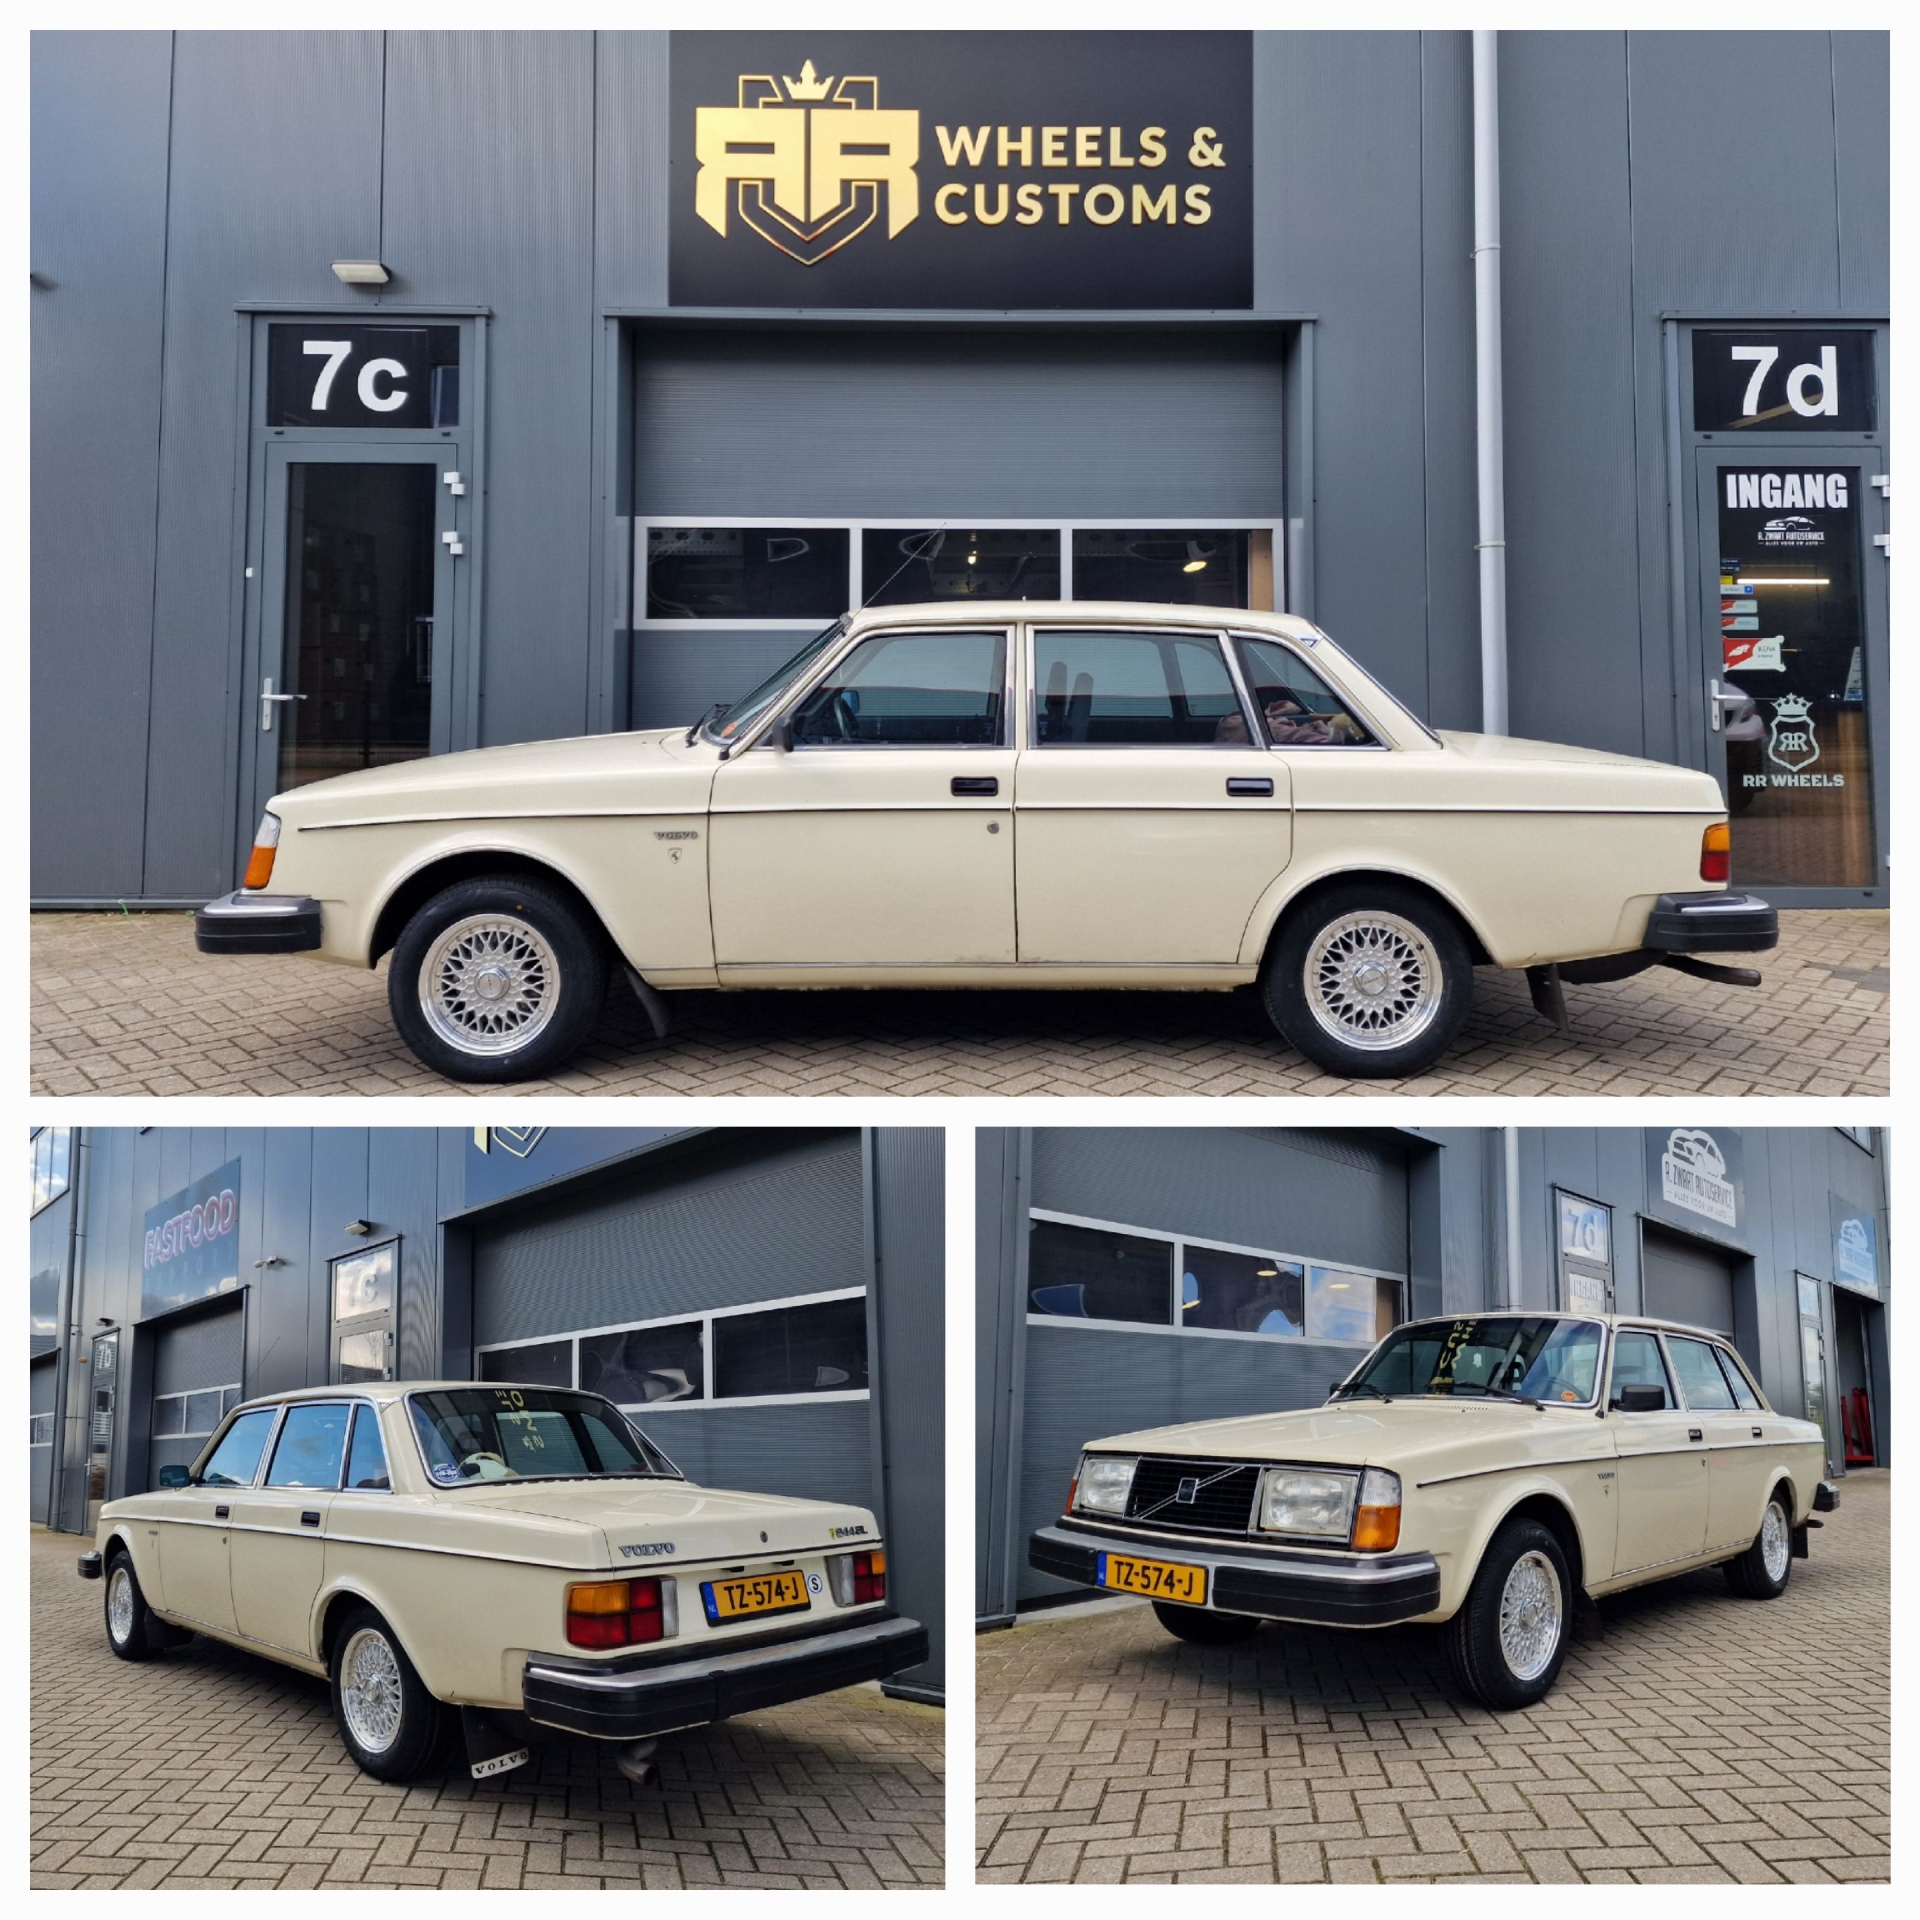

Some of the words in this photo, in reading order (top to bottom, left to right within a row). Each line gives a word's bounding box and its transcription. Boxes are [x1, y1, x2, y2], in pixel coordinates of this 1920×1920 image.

[935, 126, 1167, 168] WHEELS
[1187, 126, 1226, 168] &
[934, 183, 1212, 226] CUSTOMS
[303, 340, 409, 412] 7c
[1731, 345, 1839, 417] 7d
[1726, 473, 1849, 509] INGANG
[1742, 775, 1767, 787] RR
[1772, 774, 1845, 787] WHEELS
[144, 1188, 237, 1270] FASTFOOD
[618, 1542, 676, 1558] VOLVO
[723, 1576, 799, 1610] TZ-574-J
[811, 1577, 819, 1591] S
[1114, 1560, 1194, 1597] TZ-574-J
[707, 1604, 717, 1613] NL
[474, 1751, 528, 1775] VOLVO
